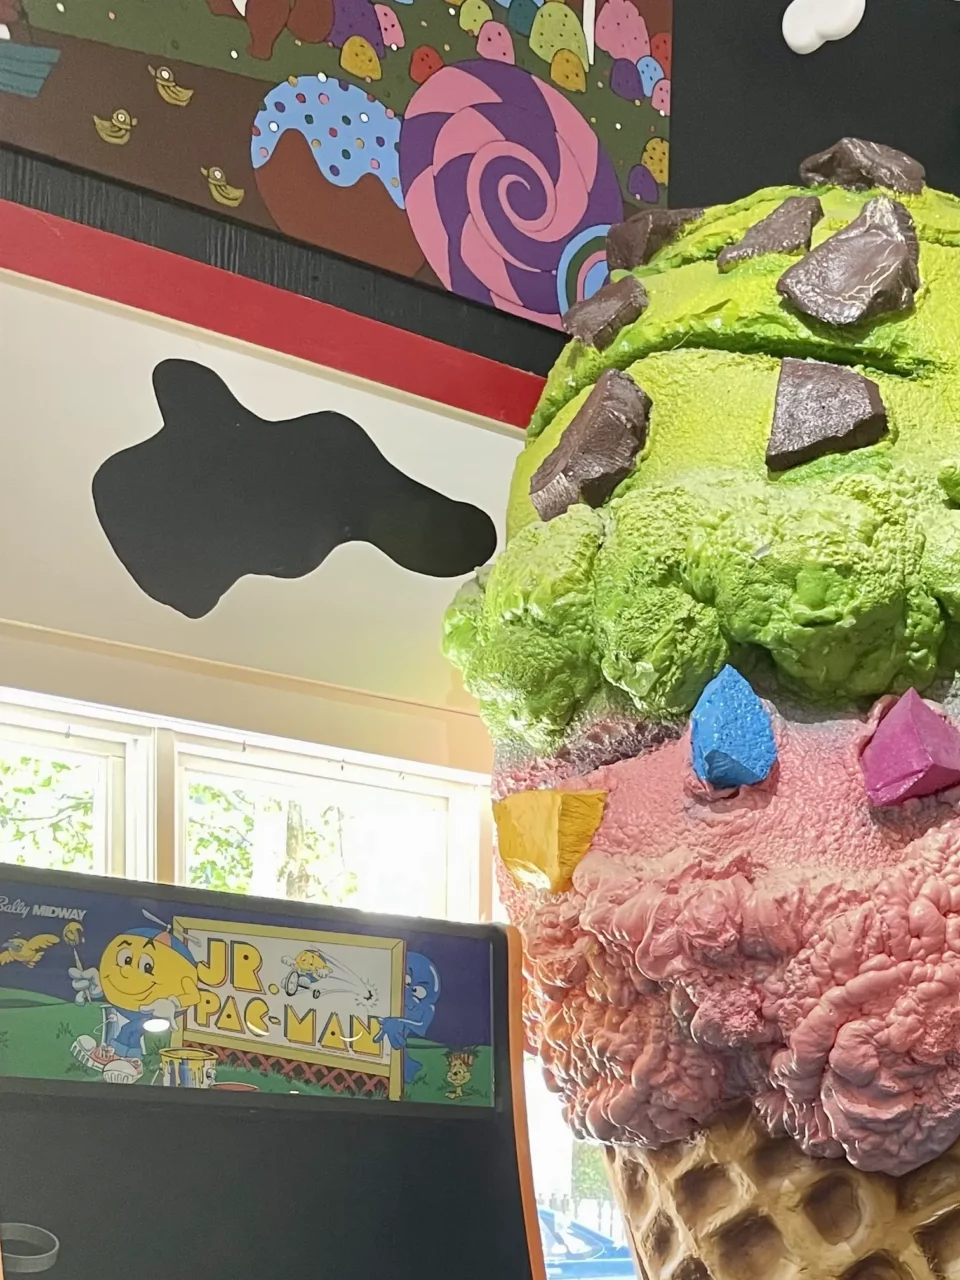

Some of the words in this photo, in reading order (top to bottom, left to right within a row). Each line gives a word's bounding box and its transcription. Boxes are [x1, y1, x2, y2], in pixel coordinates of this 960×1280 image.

[0, 895, 31, 918] Bally
[32, 905, 88, 921] MIDWAY
[197, 937, 280, 996] JR.
[194, 988, 384, 1058] PAC-MAN
